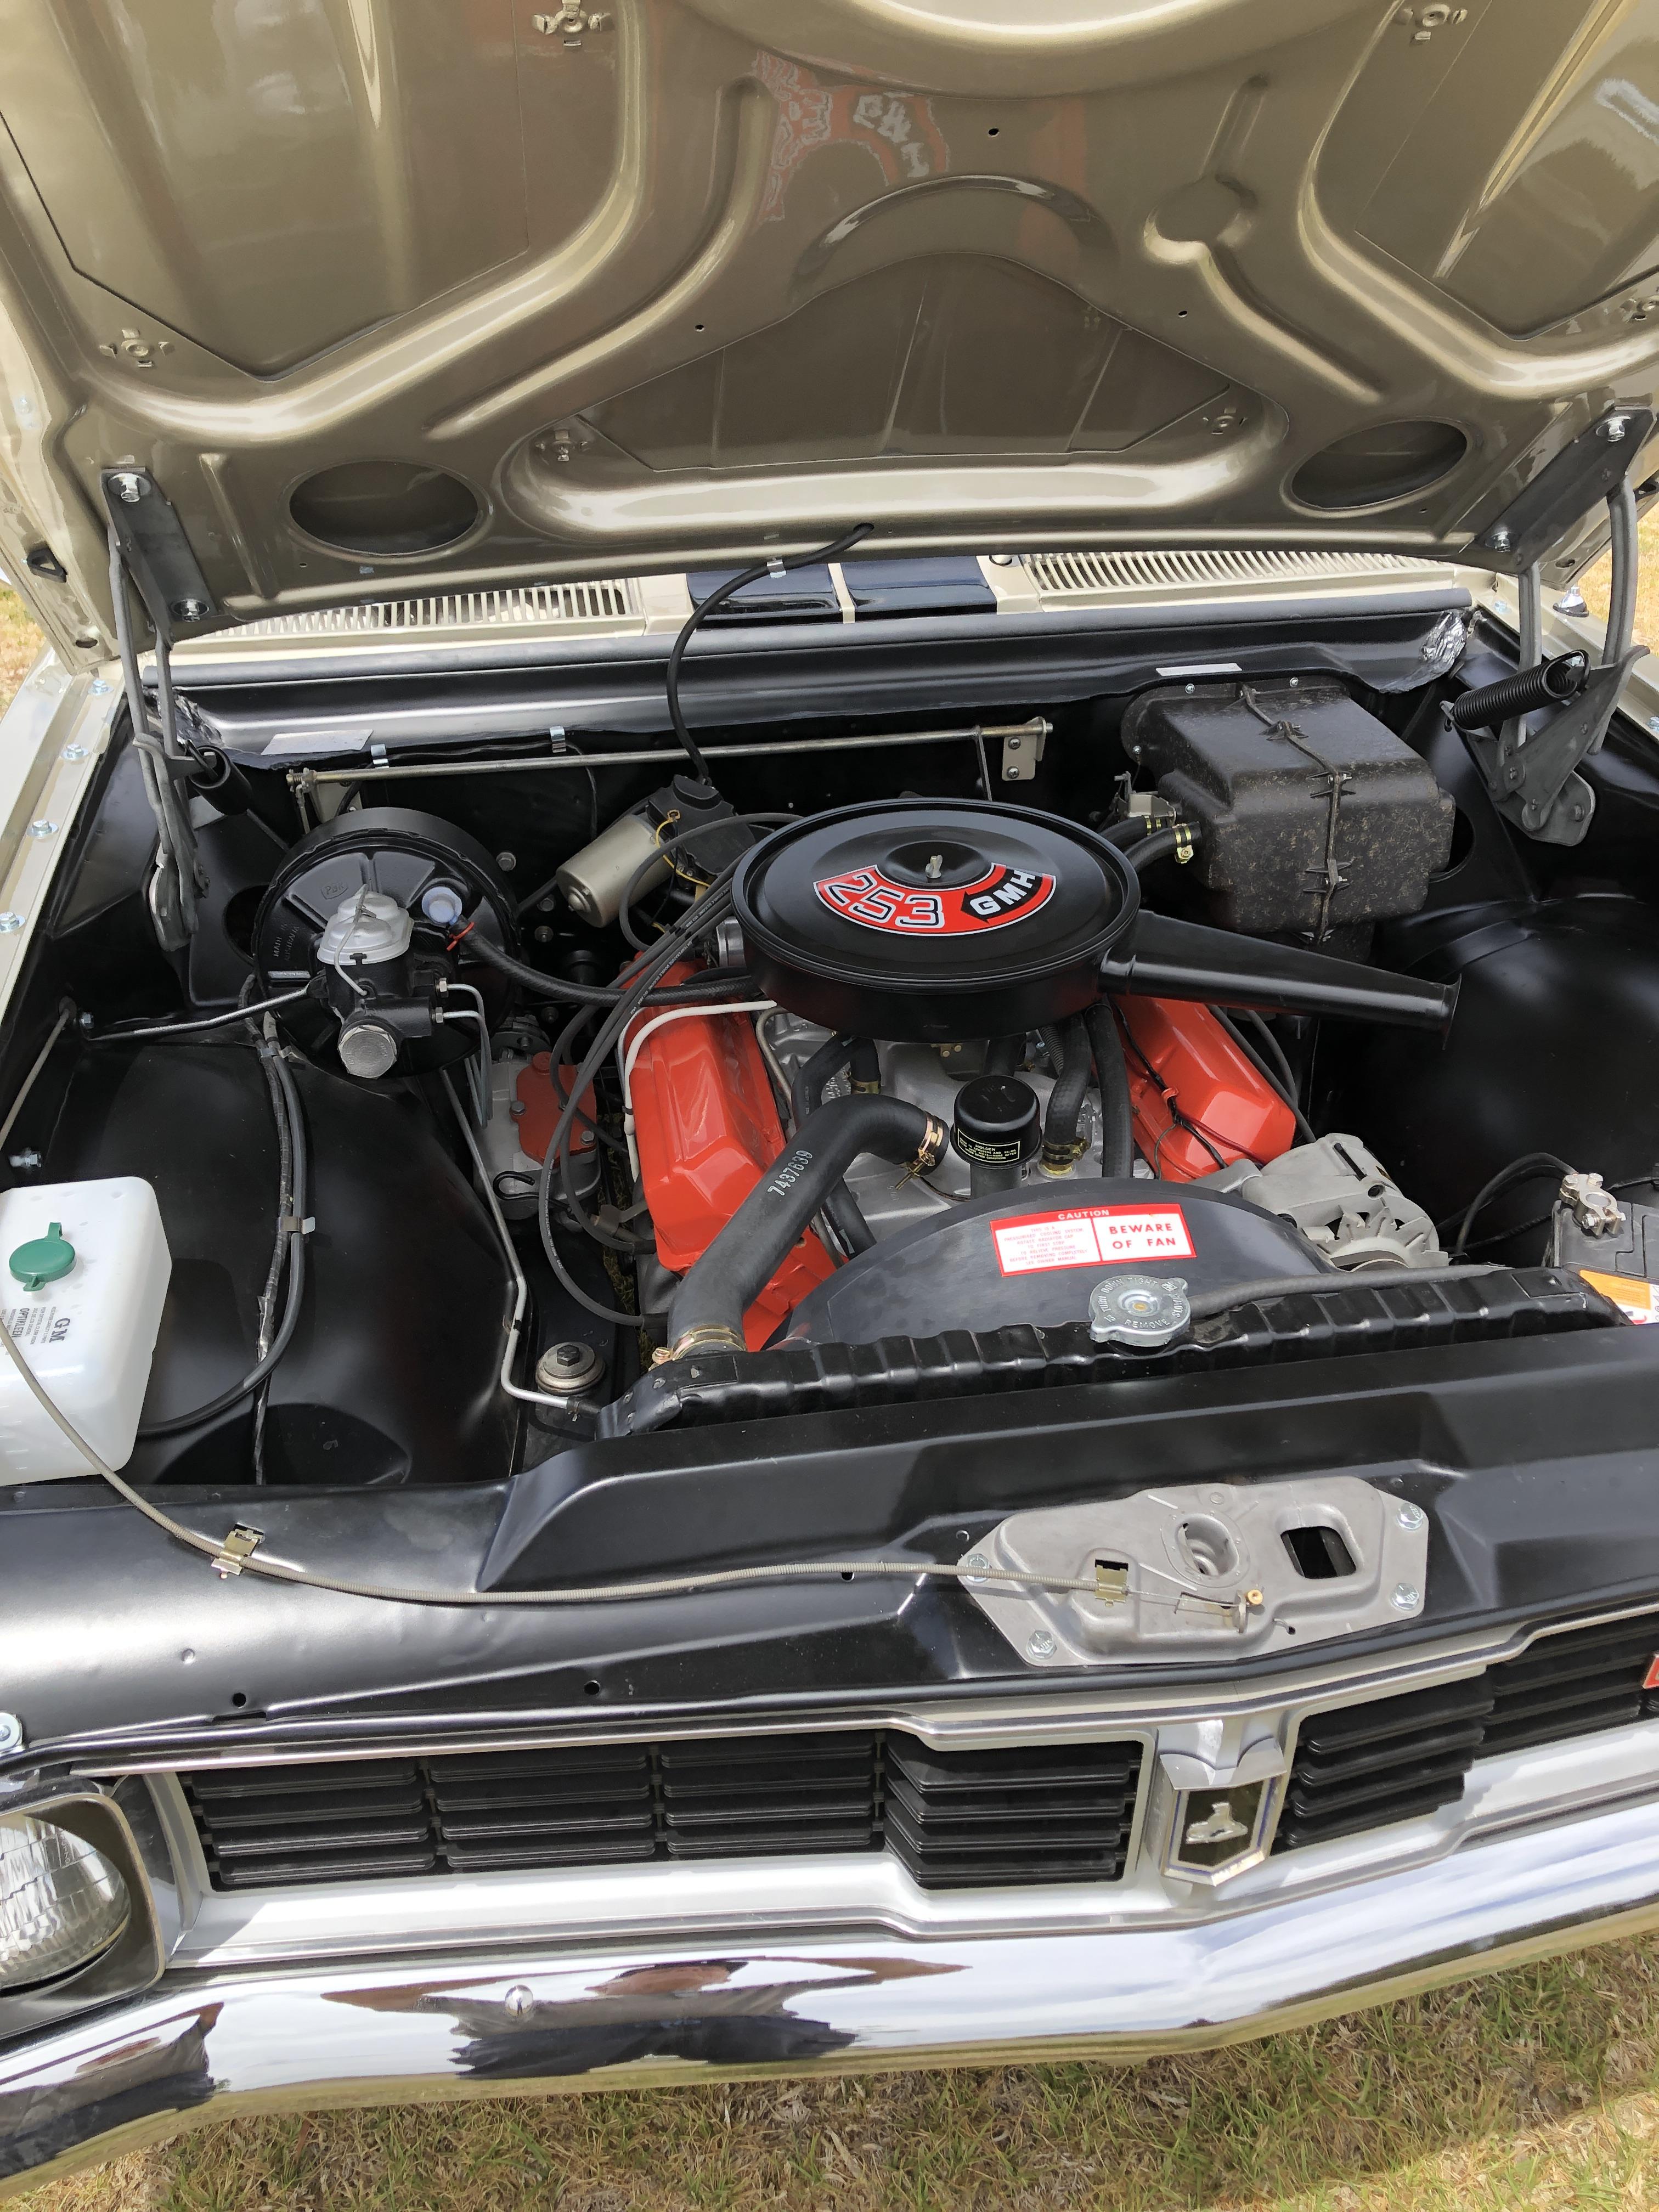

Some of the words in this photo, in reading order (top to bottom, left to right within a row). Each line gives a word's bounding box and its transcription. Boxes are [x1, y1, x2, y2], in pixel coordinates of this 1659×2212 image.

[823, 872, 945, 929] 253
[970, 870, 1036, 916] GMH
[273, 936, 282, 957] MADE
[285, 926, 300, 961] AUSTRALIA
[767, 1150, 813, 1196] 7437639
[1058, 1209, 1110, 1220] CAUTION
[1109, 1223, 1172, 1234] BEWARE
[1113, 1239, 1132, 1249] OF
[1147, 1237, 1176, 1247] FAN
[1101, 1278, 1125, 1294] DOWN
[1128, 1277, 1158, 1286] TIGHT
[1098, 1295, 1111, 1313] TURN
[11, 1308, 30, 1338] OPTIKLEEN
[36, 1313, 44, 1325] CRYSTAL
[1125, 1318, 1170, 1329] REMOVE
[49, 1318, 70, 1343] GM
